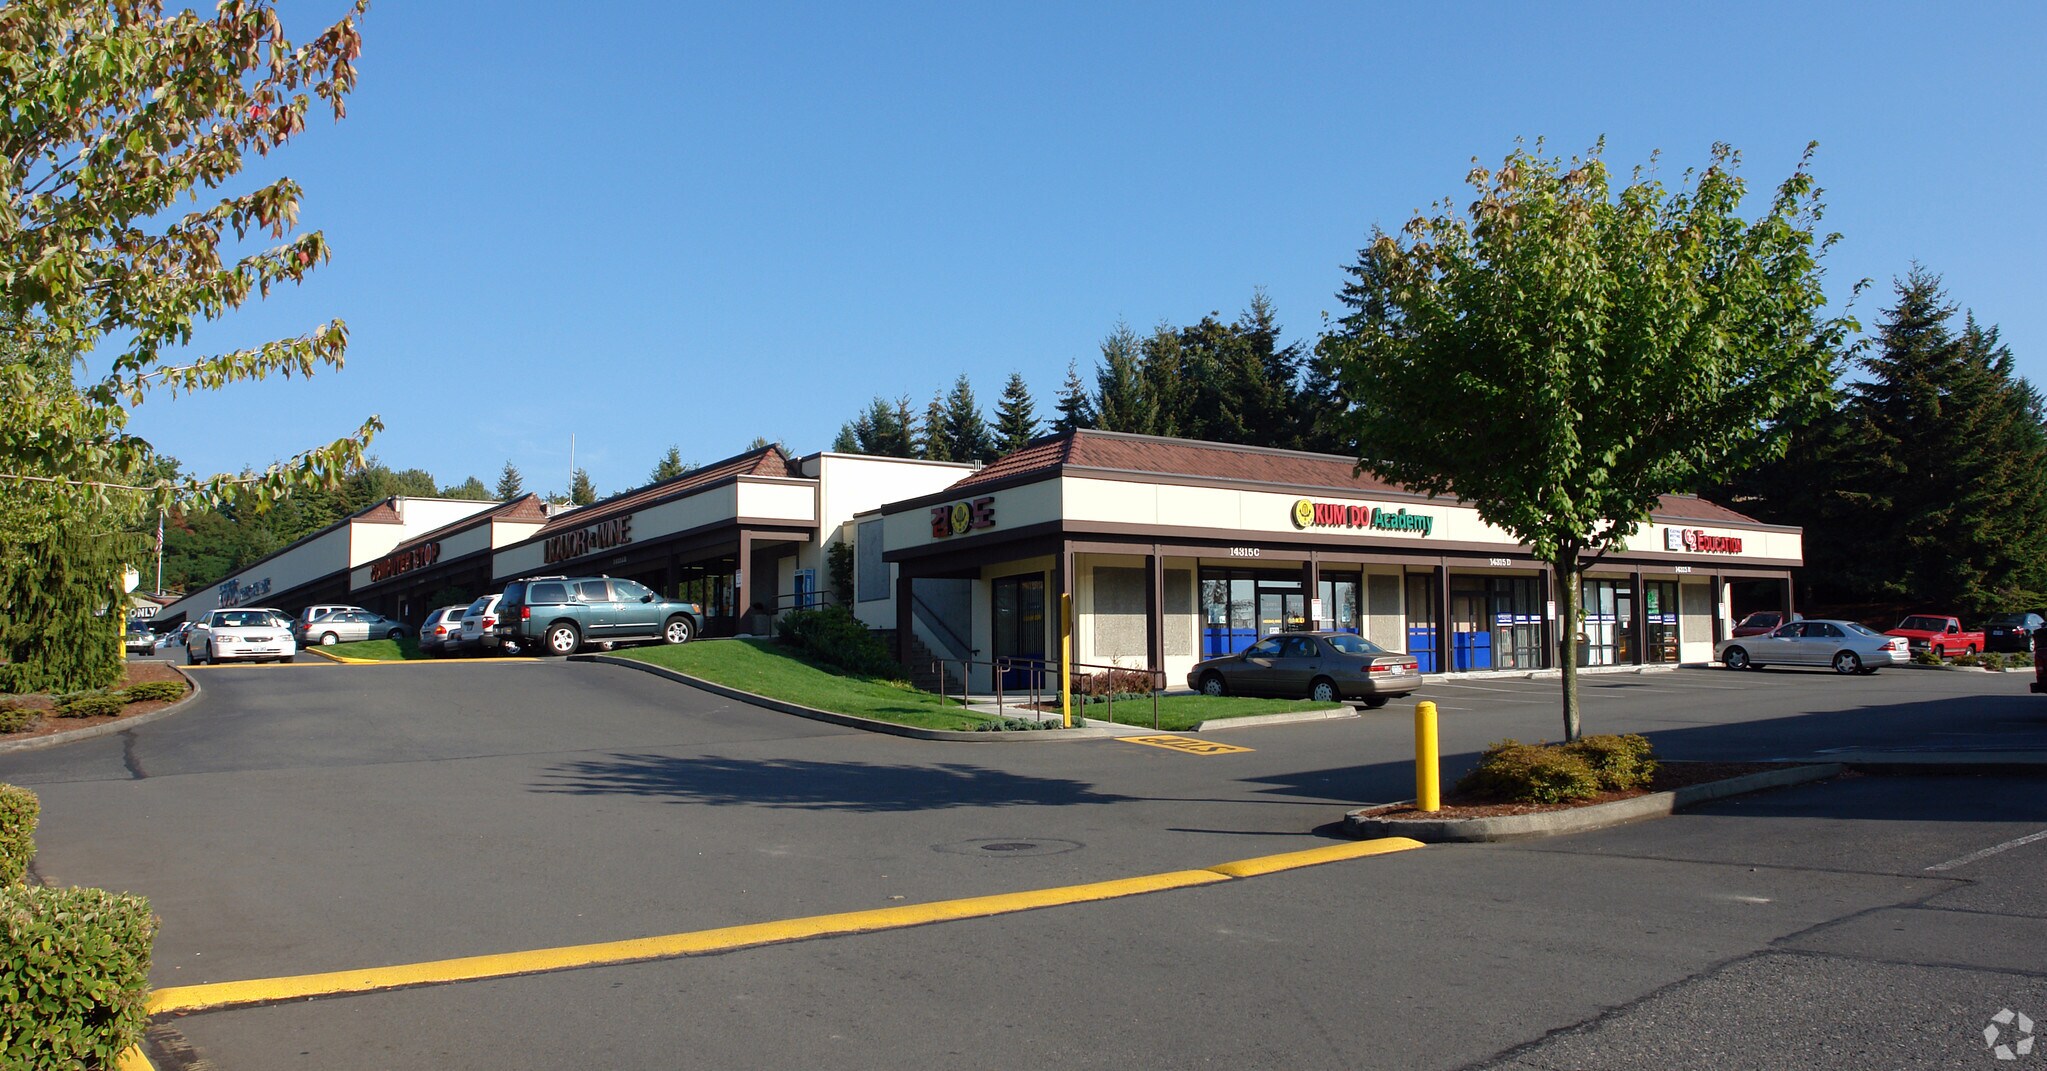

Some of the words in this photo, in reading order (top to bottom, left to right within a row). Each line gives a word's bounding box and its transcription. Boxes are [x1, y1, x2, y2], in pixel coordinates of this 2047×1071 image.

[1315, 503, 1346, 526] KUM
[1351, 505, 1370, 527] DO
[1373, 507, 1433, 535] Academy
[544, 529, 589, 564] LIQUOR
[597, 515, 632, 549] WINE
[414, 543, 440, 568] STOP
[129, 607, 158, 618] ONLY
